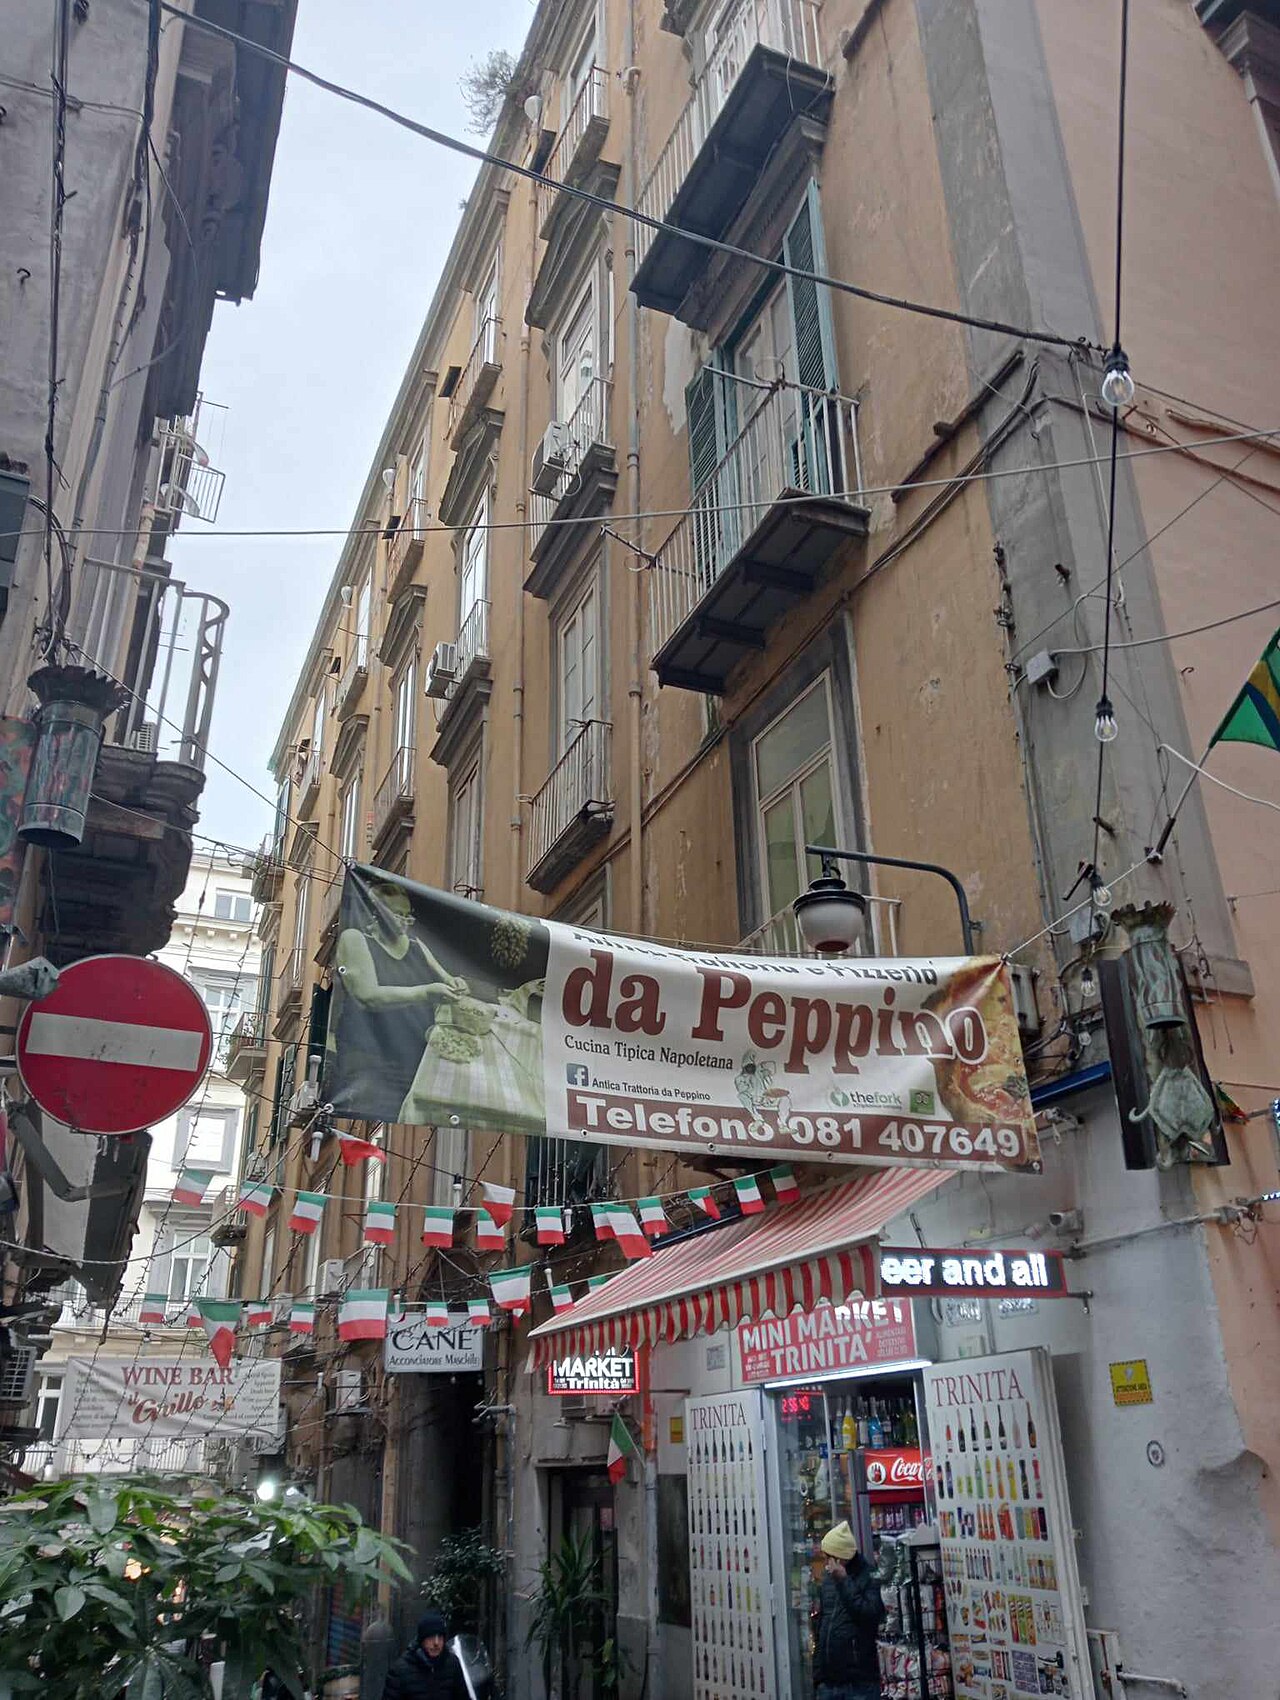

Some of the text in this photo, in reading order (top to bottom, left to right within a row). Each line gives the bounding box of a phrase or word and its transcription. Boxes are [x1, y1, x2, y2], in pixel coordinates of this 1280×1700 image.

[562, 948, 988, 1075] da Peppino
[565, 1034, 734, 1071] Cucina Tipica Napoletana
[592, 1077, 711, 1102] Antica Trattoria da Peppino
[850, 1090, 903, 1105] thefork
[576, 1096, 1020, 1158] Telefono 081 407649
[942, 1252, 1007, 1287] and
[1011, 1252, 1049, 1287] all
[742, 1318, 792, 1354] MINI
[797, 1300, 903, 1343] MARKET
[121, 1366, 234, 1386] WINE BAR
[553, 1356, 634, 1378] MARKET
[931, 1369, 1025, 1408] TRINITA
[690, 1402, 747, 1431] TRINITA
